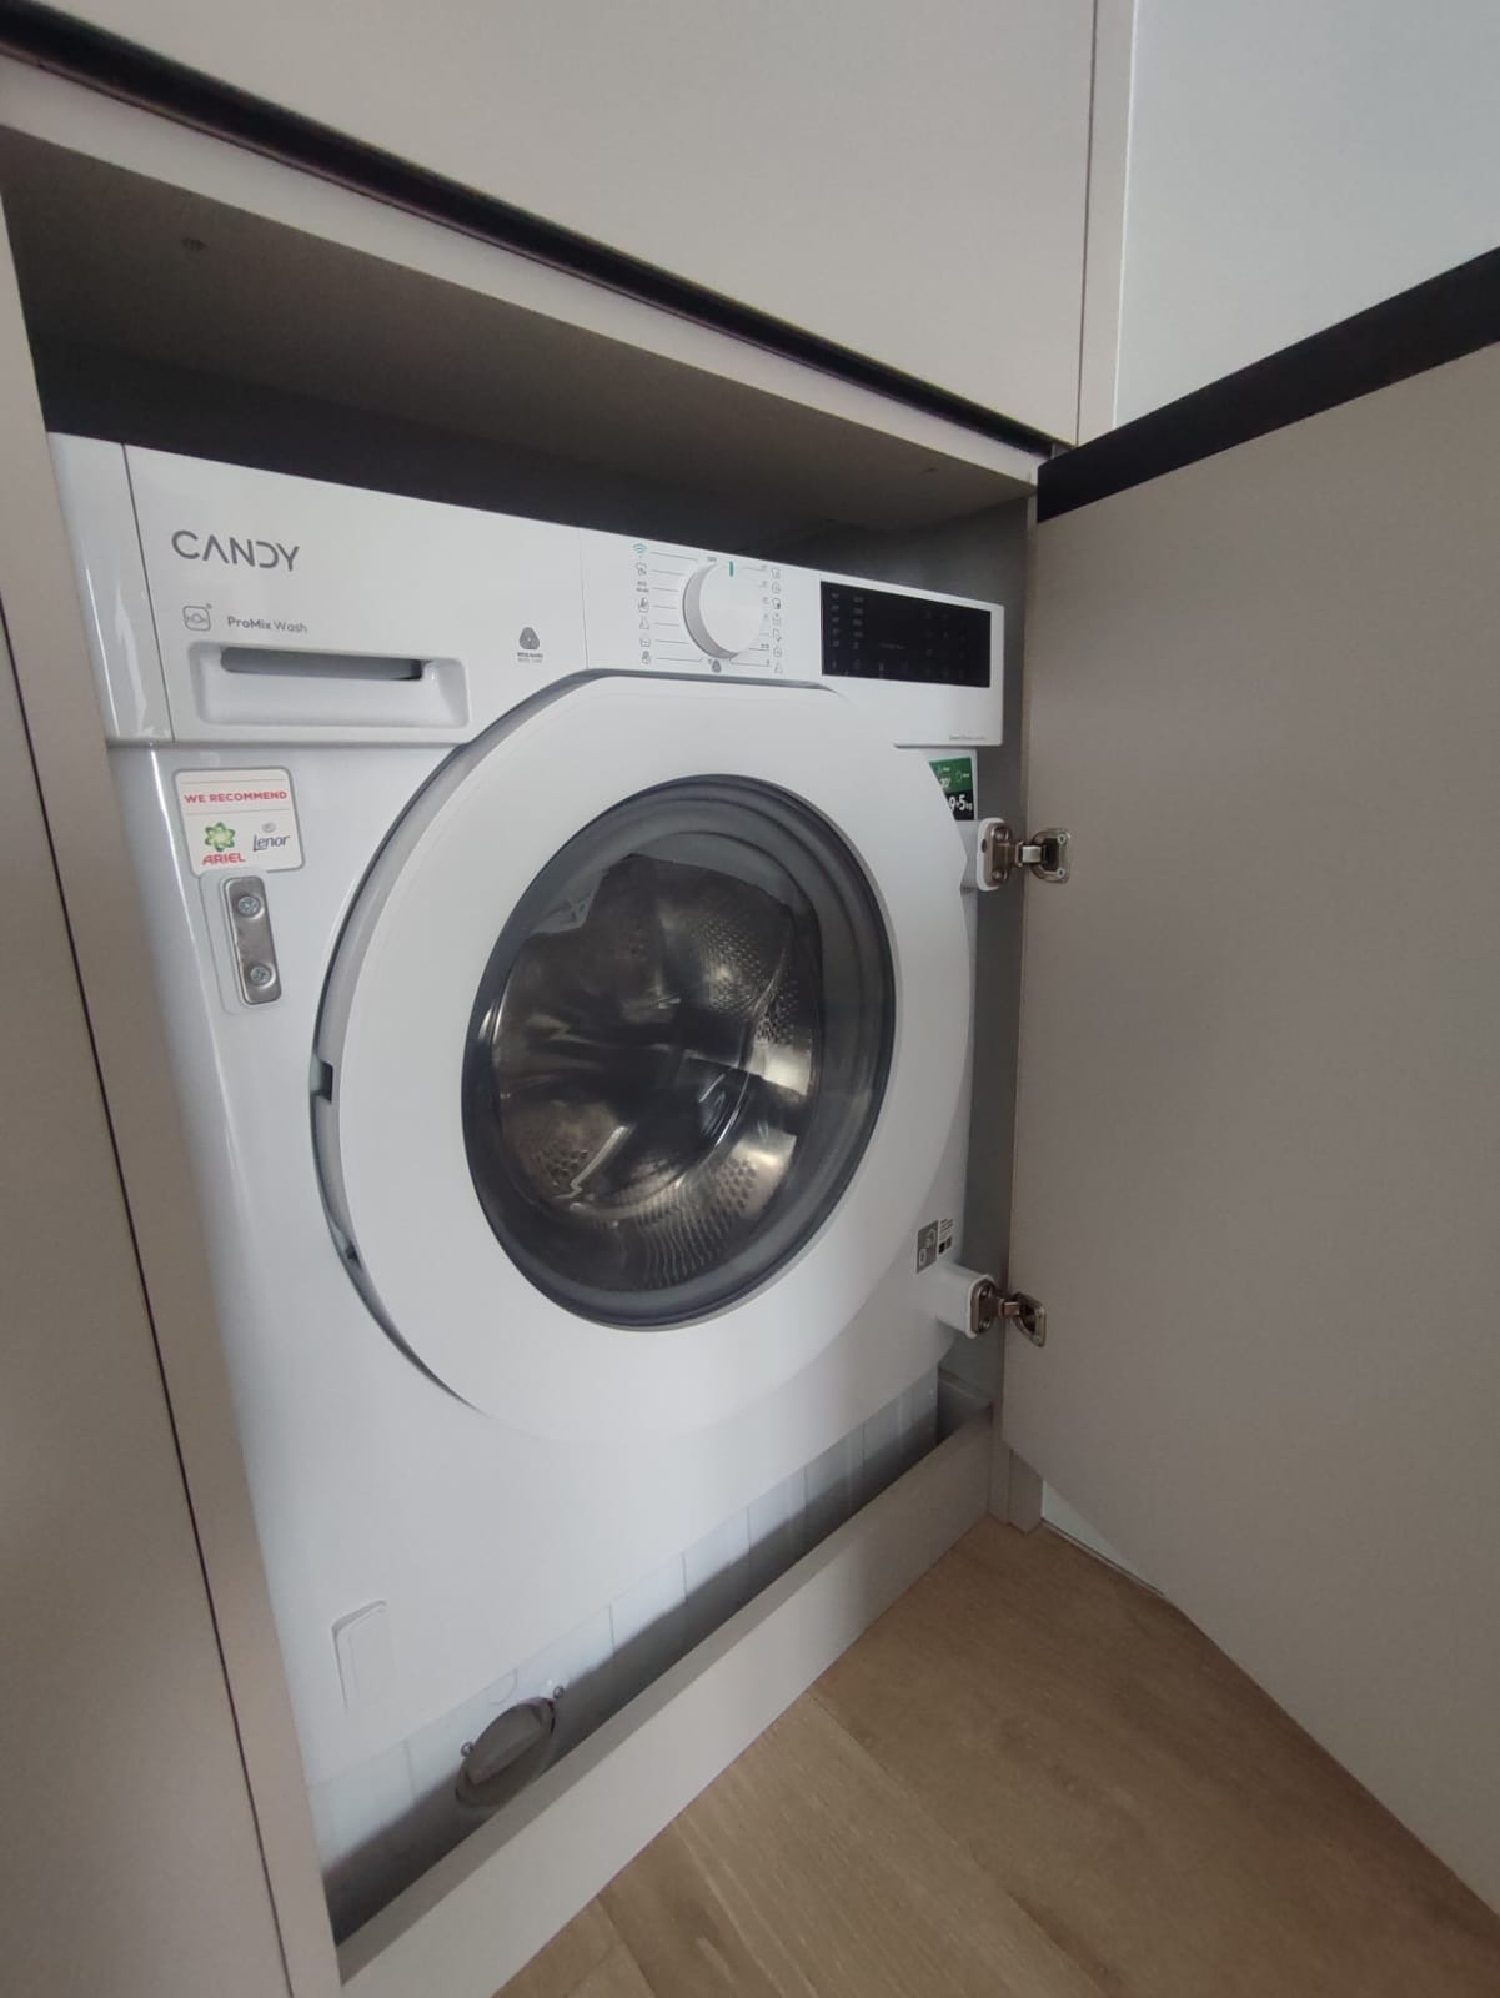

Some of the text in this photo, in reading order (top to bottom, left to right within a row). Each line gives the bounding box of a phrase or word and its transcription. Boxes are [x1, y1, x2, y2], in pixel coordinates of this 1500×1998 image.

[171, 530, 300, 572] CANDY
[226, 616, 308, 633] ProMix Wash
[184, 791, 287, 803] WE RECOMMEND
[202, 852, 246, 865] ARIEL
